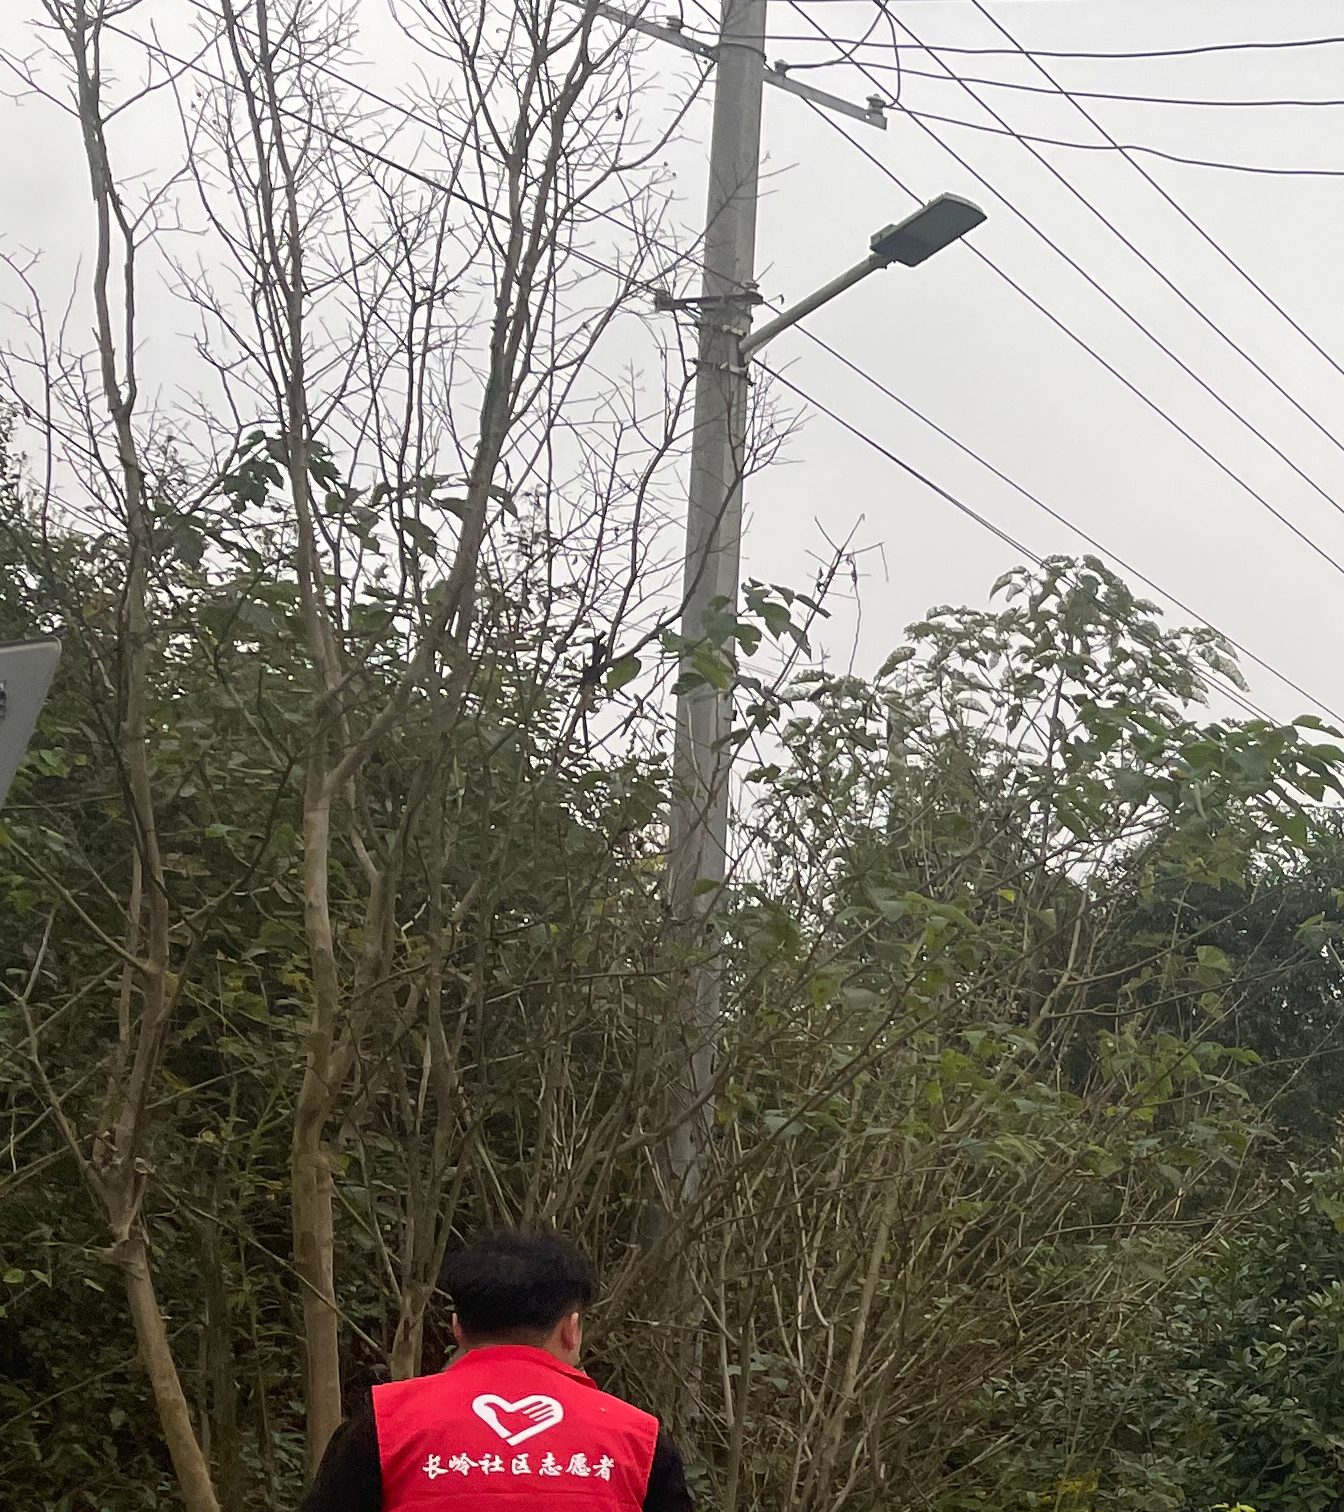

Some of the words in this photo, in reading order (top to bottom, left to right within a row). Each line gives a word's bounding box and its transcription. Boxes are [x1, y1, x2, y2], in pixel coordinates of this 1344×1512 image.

[421, 1452, 616, 1482] 长岭社区志愿者
